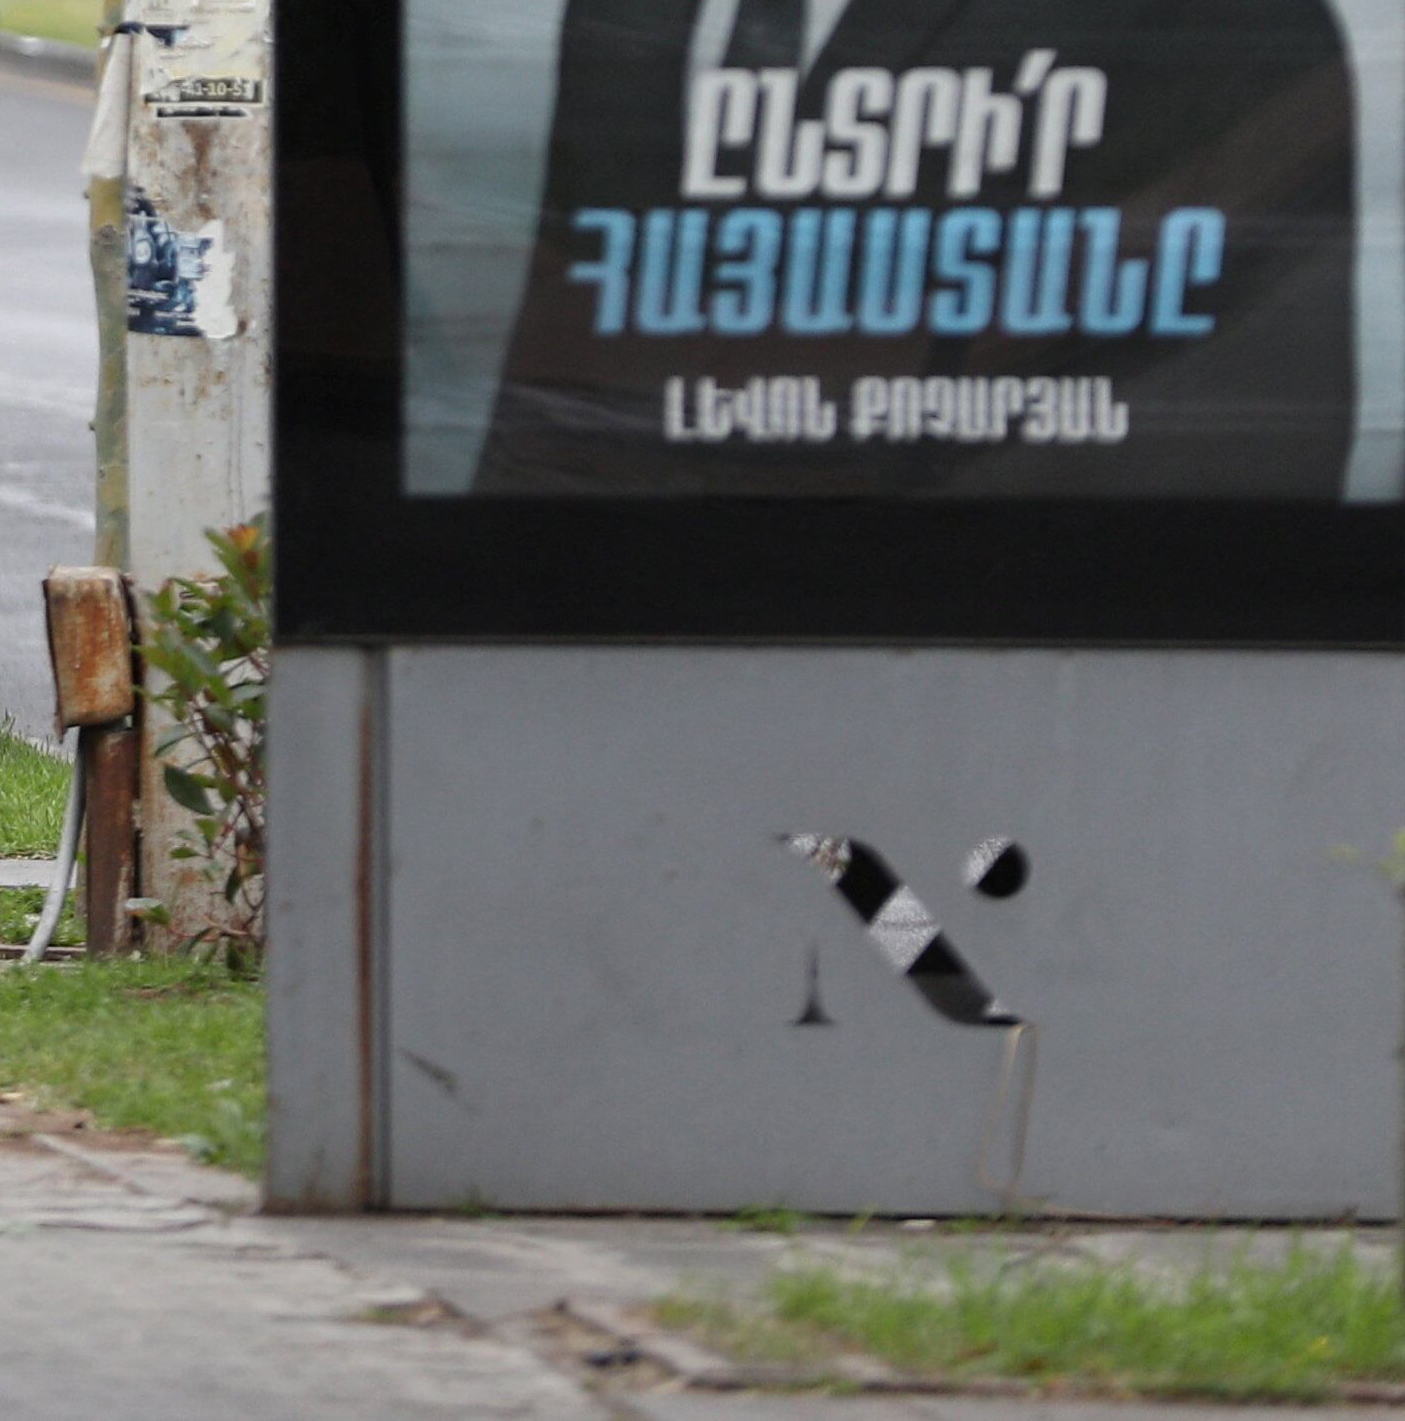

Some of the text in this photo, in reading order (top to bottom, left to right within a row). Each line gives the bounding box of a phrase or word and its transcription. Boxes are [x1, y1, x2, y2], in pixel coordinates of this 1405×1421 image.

[566, 205, 1227, 336] ՀԱՅԱՍՏԱՆԸ
[664, 376, 1129, 442] ԼԵՎՈՆ ՔՈՉԱՐՅԱՆ
